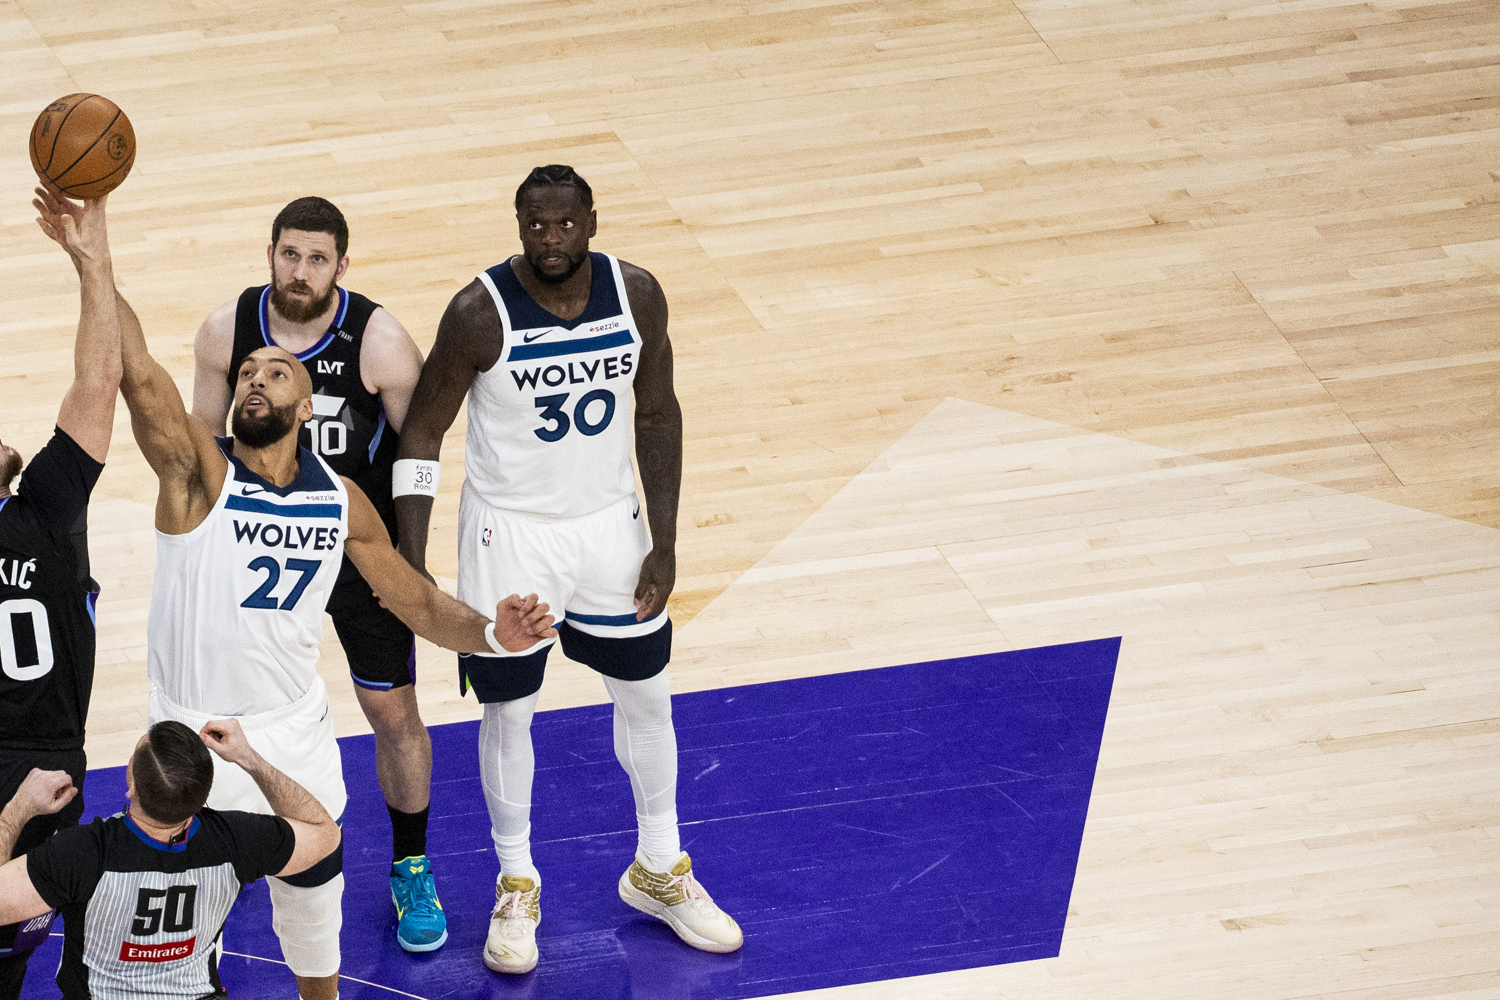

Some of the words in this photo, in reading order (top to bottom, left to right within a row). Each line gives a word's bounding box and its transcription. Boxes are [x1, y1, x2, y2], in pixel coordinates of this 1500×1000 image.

[595, 321, 619, 332] sezzle
[317, 360, 345, 375] LVT
[510, 352, 633, 391] WOLVES
[533, 388, 616, 443] 30
[304, 419, 347, 456] 10
[415, 471, 433, 484] 30
[233, 519, 339, 551] WOLVES
[240, 555, 322, 611] 27
[22, 912, 53, 932] UTAH
[130, 884, 197, 936] 50
[128, 944, 189, 959] Emirates
